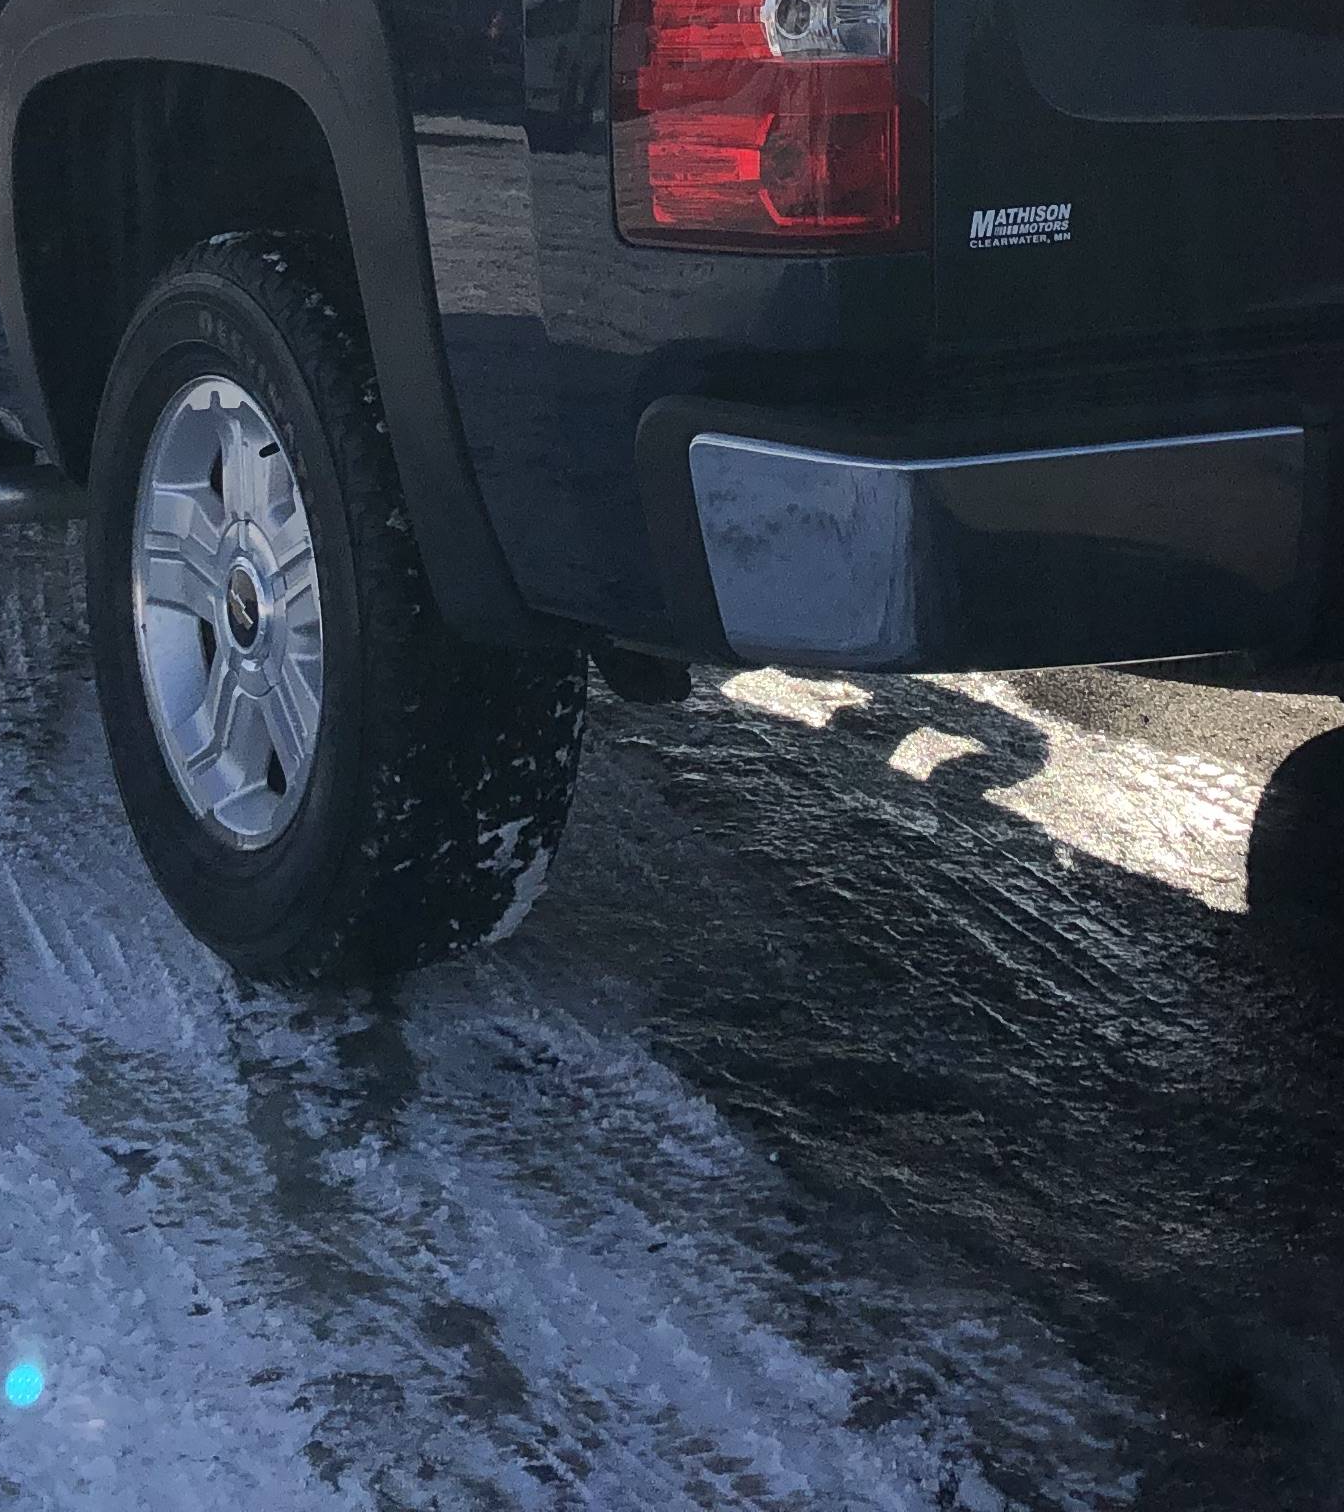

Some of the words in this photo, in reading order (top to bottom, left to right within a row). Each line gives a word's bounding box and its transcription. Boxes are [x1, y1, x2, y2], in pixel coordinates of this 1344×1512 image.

[970, 203, 1072, 238] MATHISON
[1019, 220, 1069, 234] MOTORS
[969, 234, 1051, 248] CLEARWATER,
[1054, 232, 1071, 241] MN
